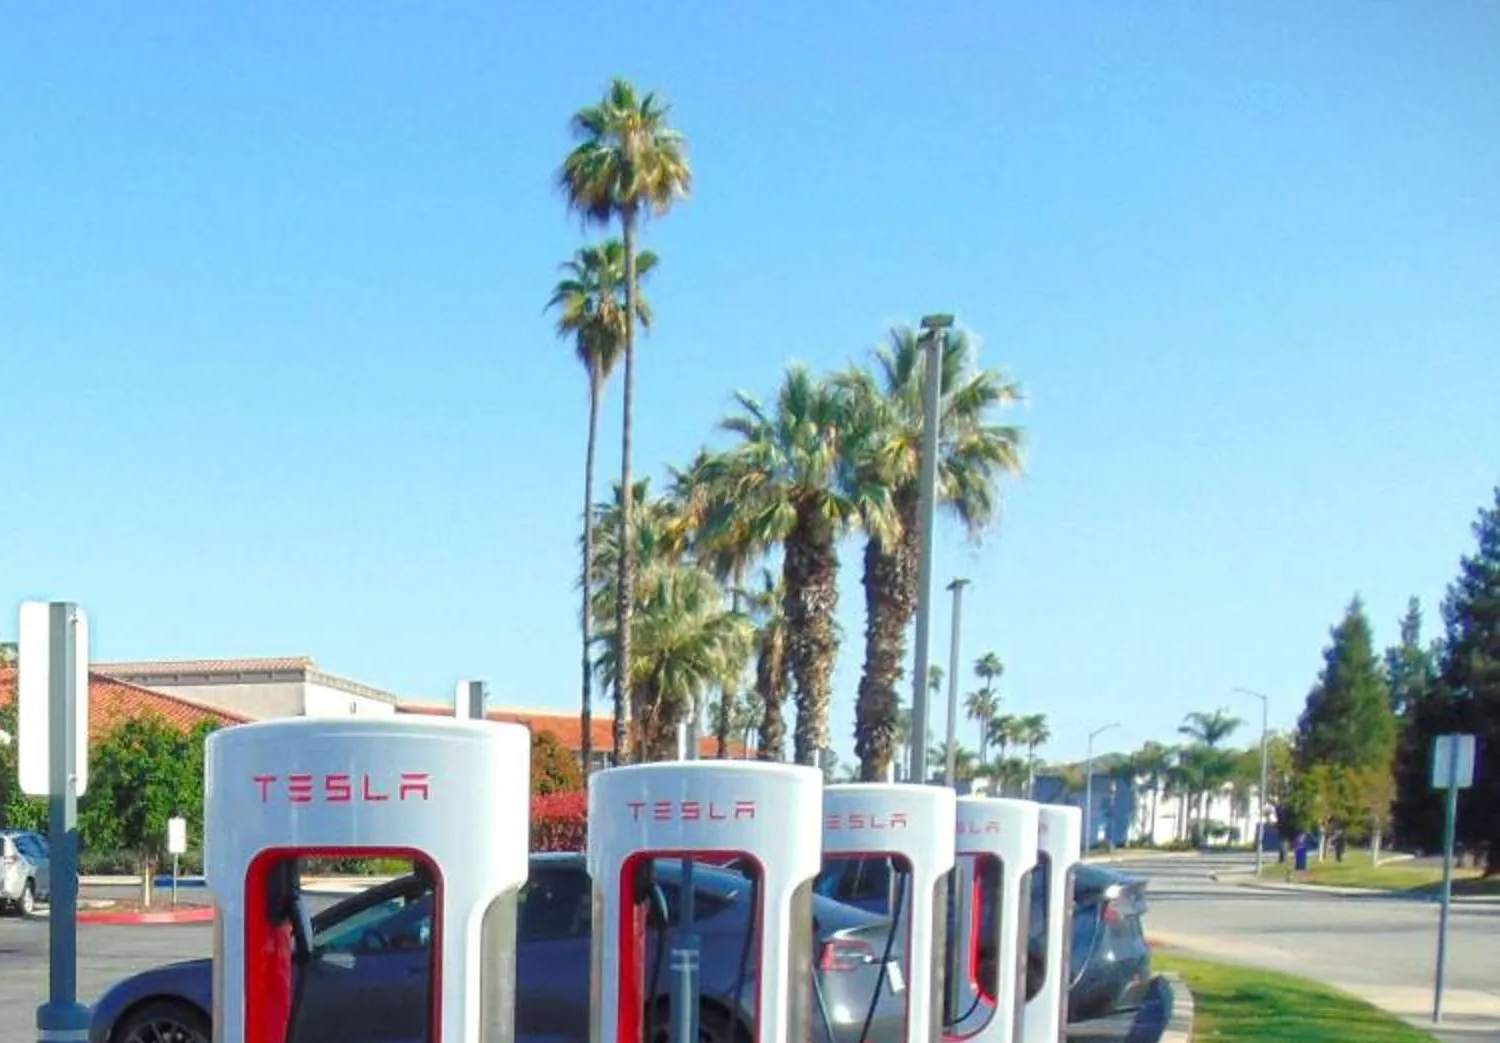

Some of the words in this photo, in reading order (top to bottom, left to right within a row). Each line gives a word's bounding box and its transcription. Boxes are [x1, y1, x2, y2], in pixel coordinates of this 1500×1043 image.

[252, 772, 430, 803] TESLA
[626, 800, 756, 822] TESLA
[825, 813, 908, 830] ESLA
